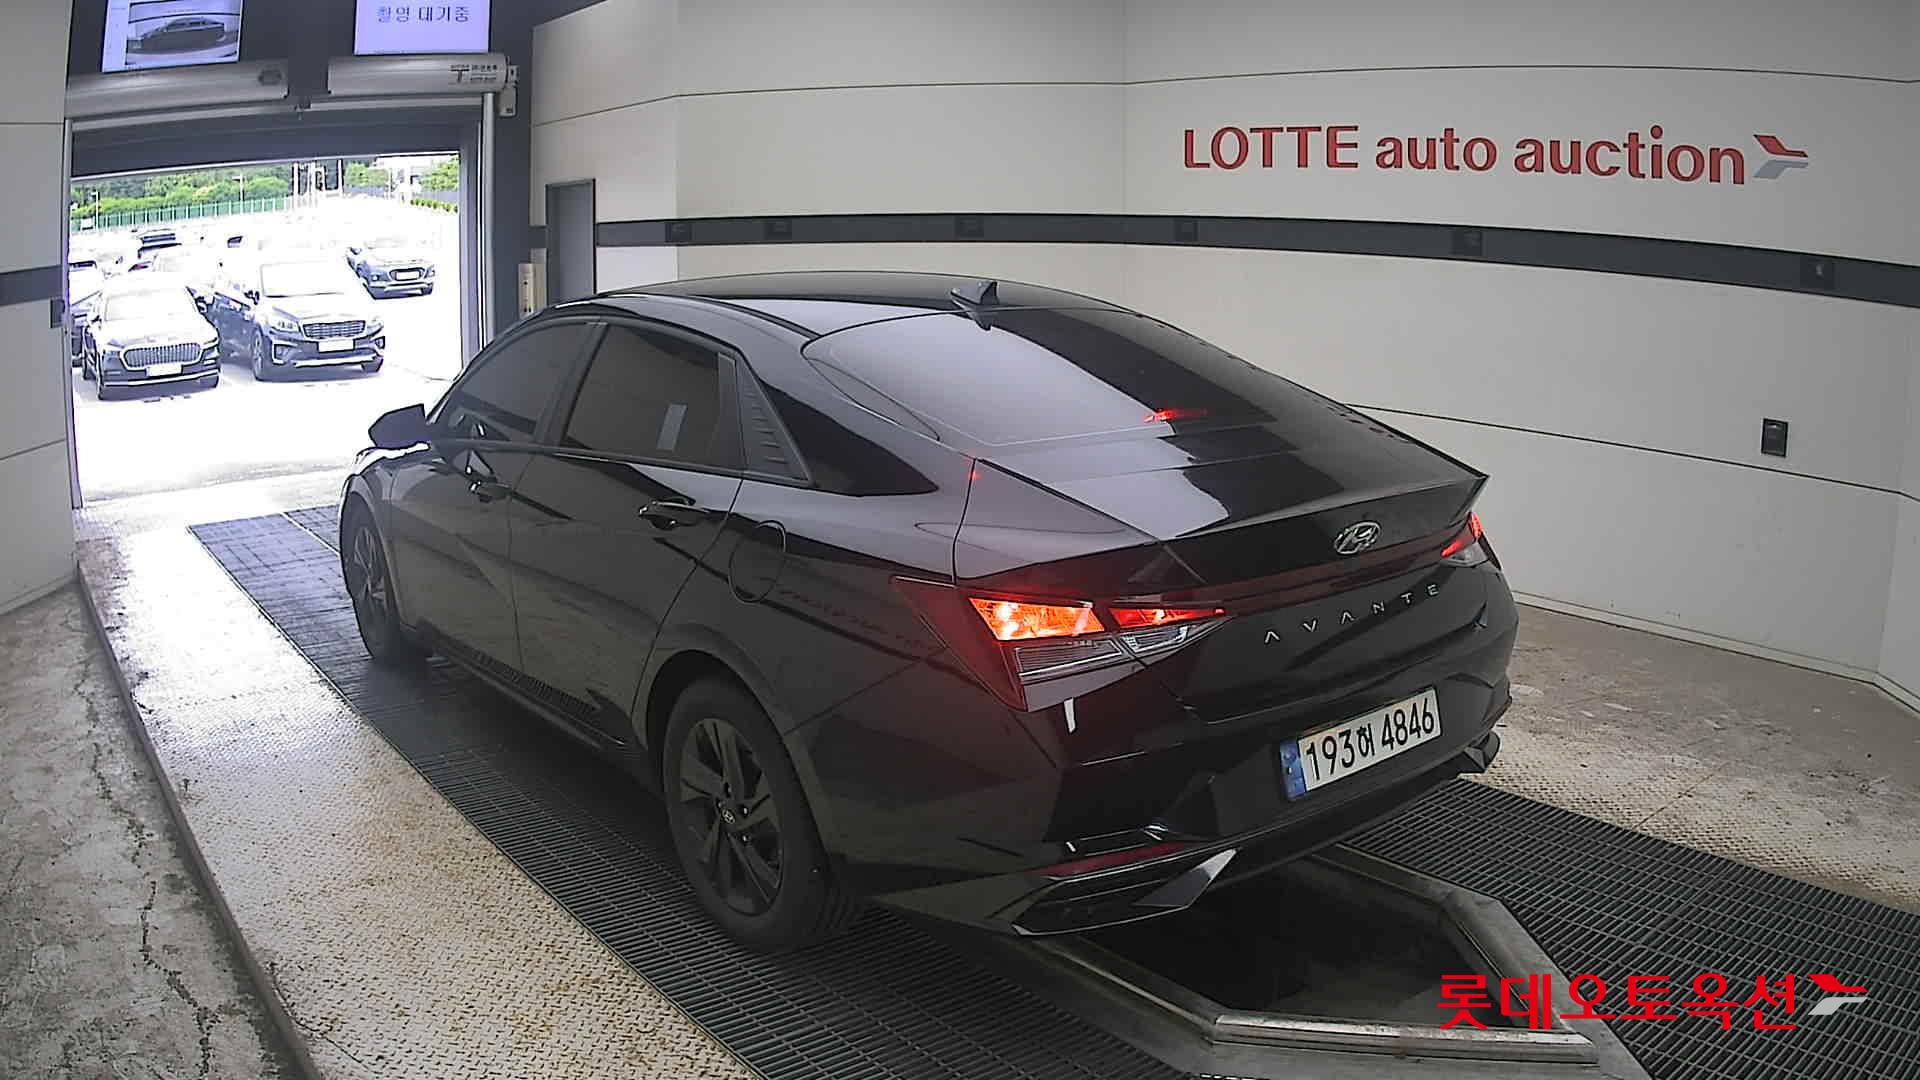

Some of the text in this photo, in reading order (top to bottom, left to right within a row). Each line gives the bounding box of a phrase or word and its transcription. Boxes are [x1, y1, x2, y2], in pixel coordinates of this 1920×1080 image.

[418, 6, 470, 23] 대기중
[1184, 124, 1745, 185] LOTTE auto auction
[1264, 583, 1439, 645] AVANTE
[1381, 697, 1436, 751] 4846
